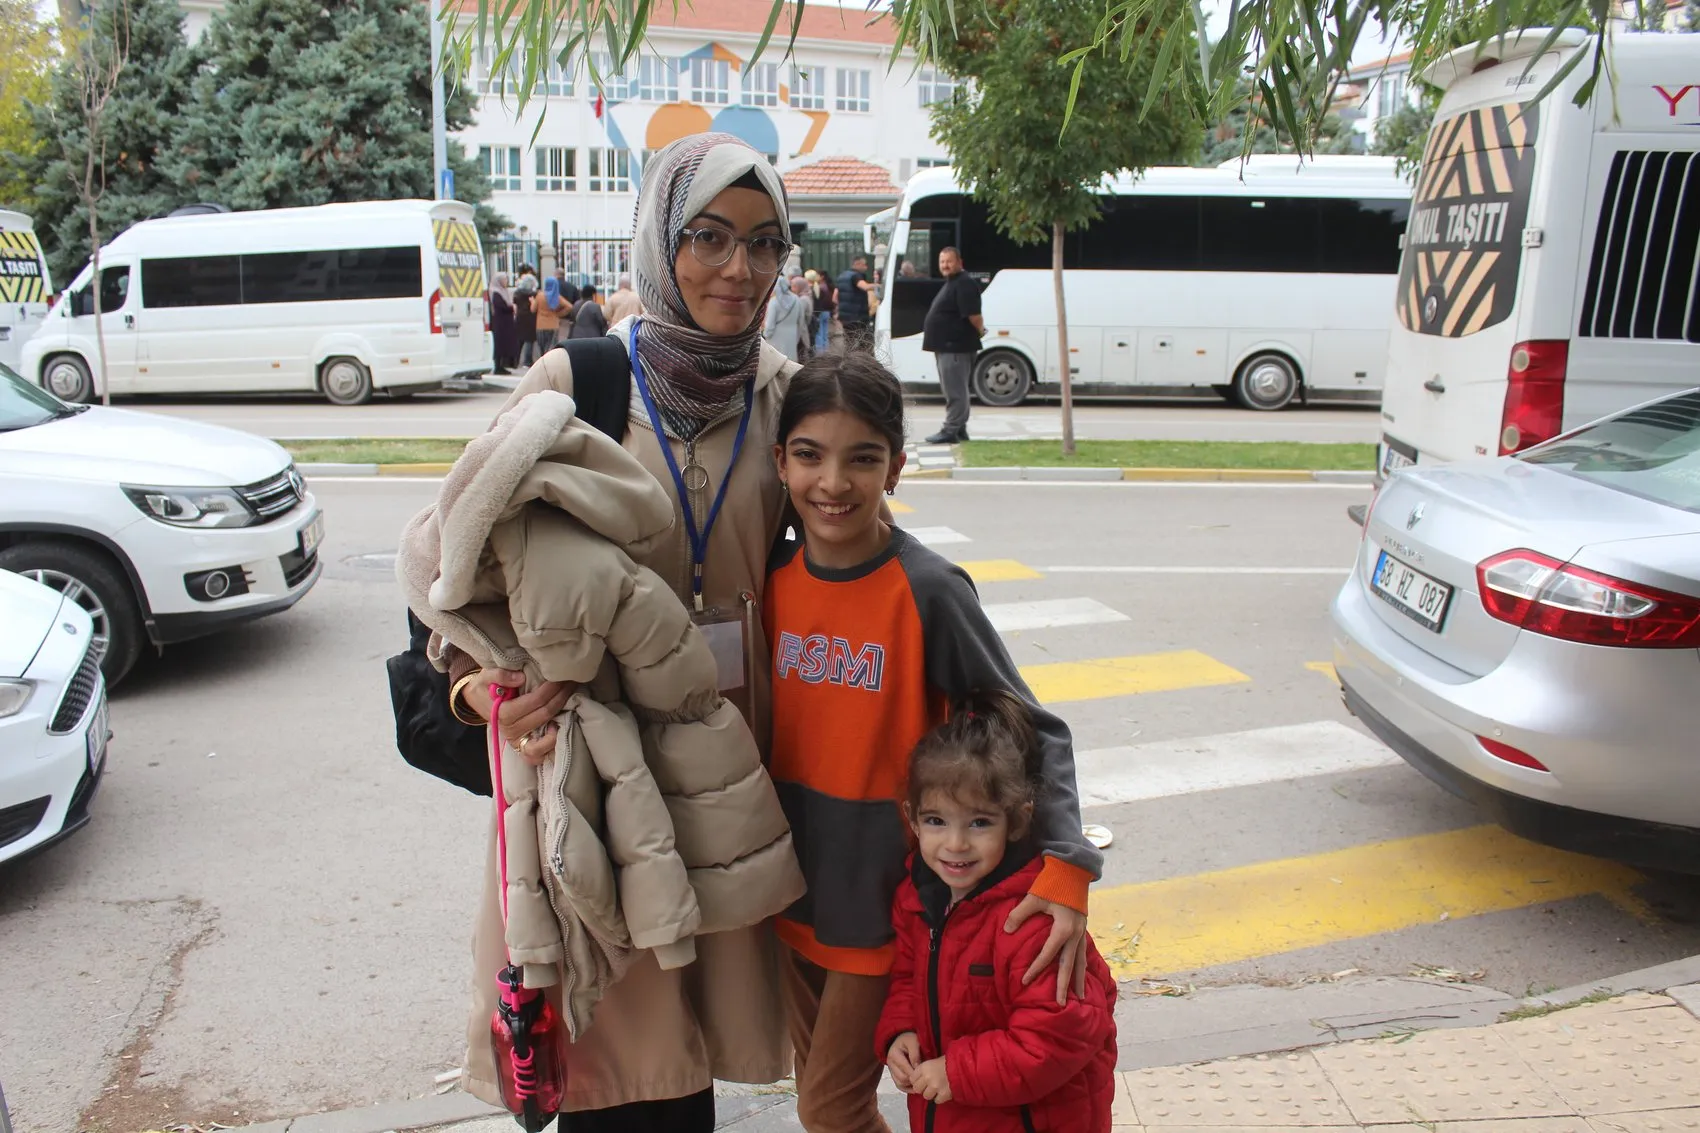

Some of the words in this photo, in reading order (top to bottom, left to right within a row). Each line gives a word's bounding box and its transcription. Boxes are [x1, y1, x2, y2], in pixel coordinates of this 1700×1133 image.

[1651, 85, 1700, 117] Y
[1445, 202, 1509, 250] TAŞITI
[1380, 560, 1394, 587] 68
[1396, 569, 1415, 600] HZ
[1419, 583, 1446, 617] 087
[776, 631, 884, 692] FSM
